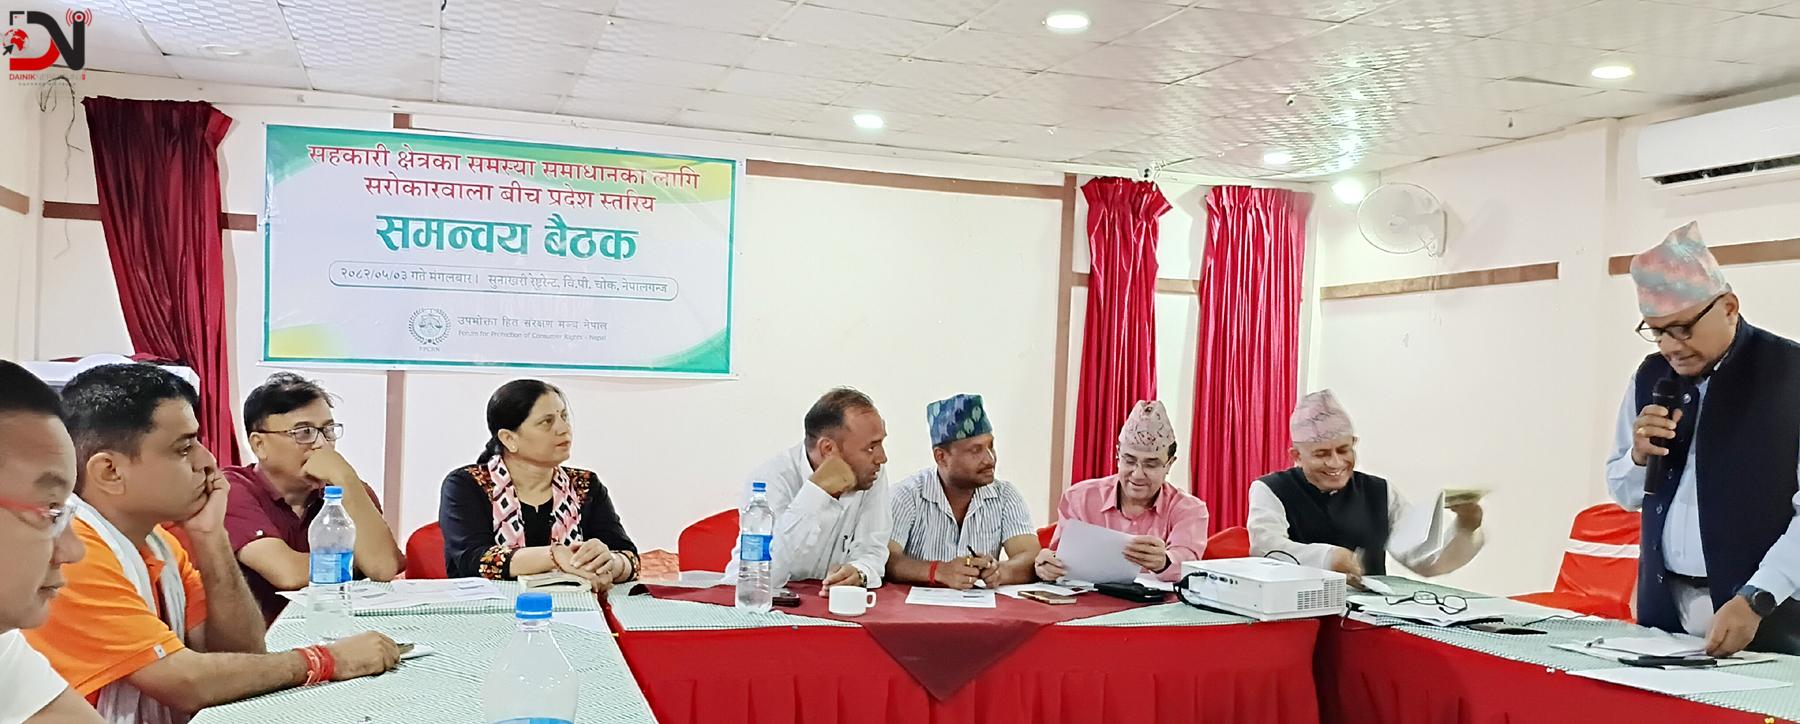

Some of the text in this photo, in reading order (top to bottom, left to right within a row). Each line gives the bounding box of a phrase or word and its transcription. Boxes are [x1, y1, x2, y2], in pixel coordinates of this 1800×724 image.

[308, 144, 700, 189] सहकारी क्षेत्रका समस्या समाधानका लागि
[364, 171, 656, 212] सरोकारवाला बीच प्रदेश स्तरिय
[376, 213, 640, 260] समन्वय बैठक
[341, 267, 408, 281] २०८२/०५/०३
[411, 268, 427, 281] गते
[429, 270, 473, 284] मंगलवार
[457, 314, 498, 327] उपभोक्ता
[502, 315, 519, 328] हित
[584, 319, 608, 331] नेपाल
